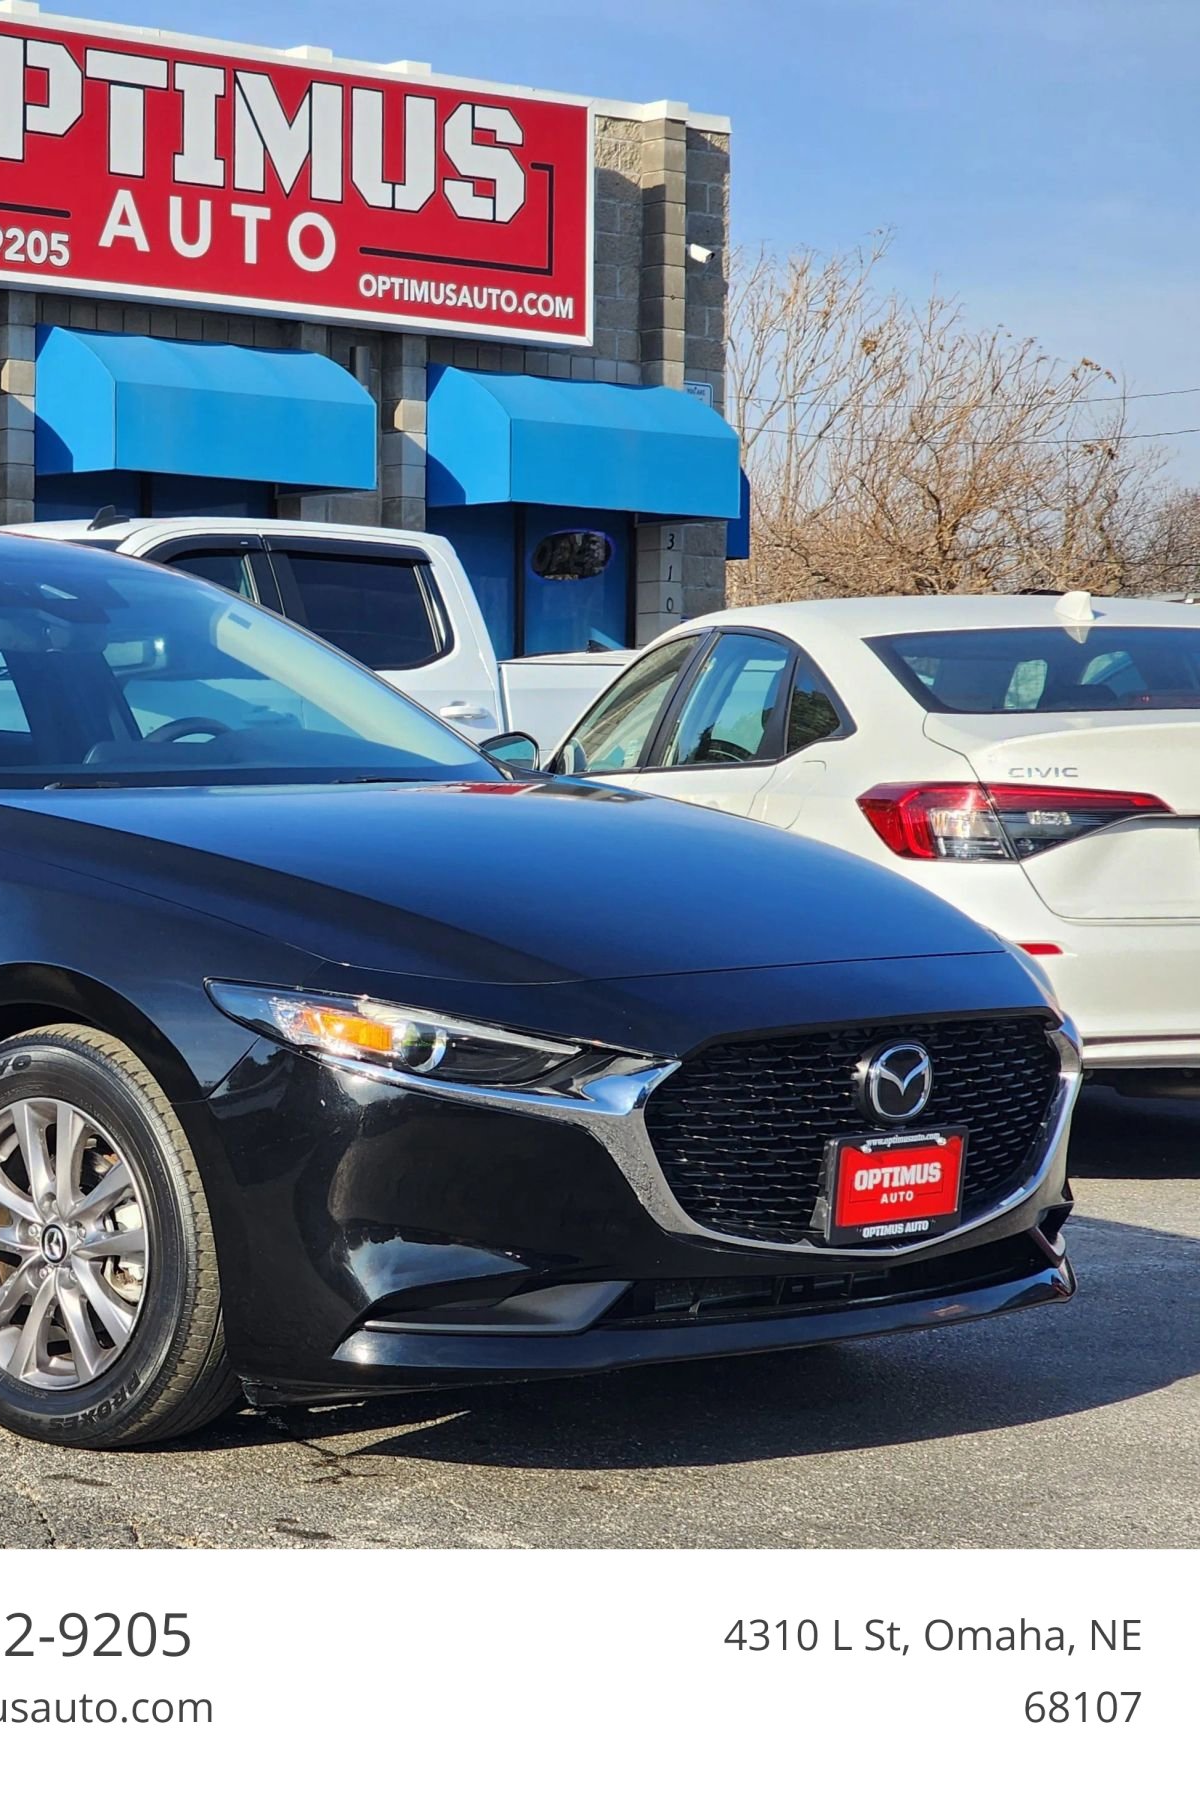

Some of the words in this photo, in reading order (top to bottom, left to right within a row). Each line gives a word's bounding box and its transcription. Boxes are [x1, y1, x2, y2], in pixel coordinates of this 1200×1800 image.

[99, 189, 337, 272] AUTO
[358, 272, 575, 320] OPTIMUSAUTO.COM
[1008, 766, 1079, 778] CIVIC
[854, 1161, 942, 1191] OPTIMUS
[880, 1190, 914, 1204] AUTO
[862, 1223, 904, 1238] OPTIMUS
[904, 1220, 929, 1233] AUTO
